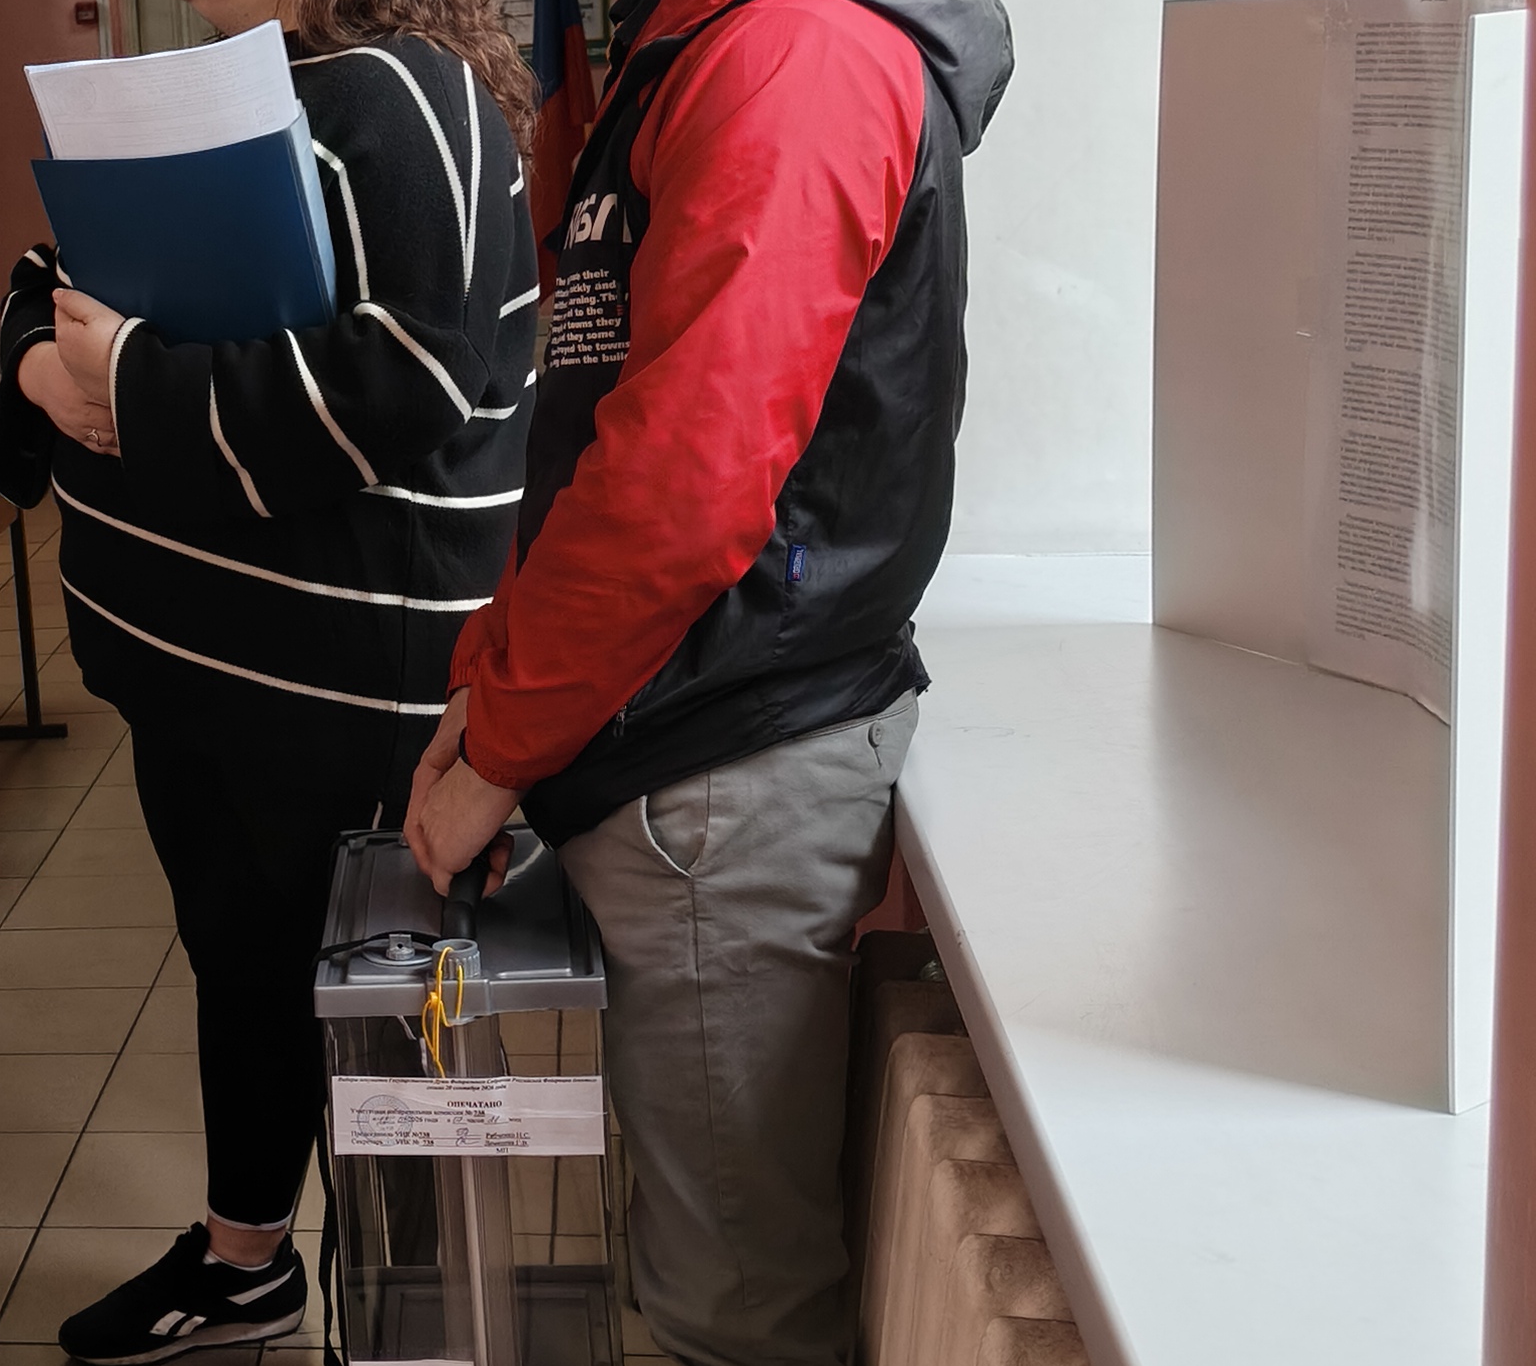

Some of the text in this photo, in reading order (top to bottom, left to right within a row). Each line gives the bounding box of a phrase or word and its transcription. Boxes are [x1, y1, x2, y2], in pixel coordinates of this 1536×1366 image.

[582, 268, 610, 280] their
[595, 279, 617, 291] and
[586, 306, 604, 316] the
[596, 317, 622, 328] they
[586, 330, 616, 341] some
[577, 343, 593, 354] the
[583, 354, 599, 365] the
[447, 1100, 503, 1108] ОПЕЧАТАНО
